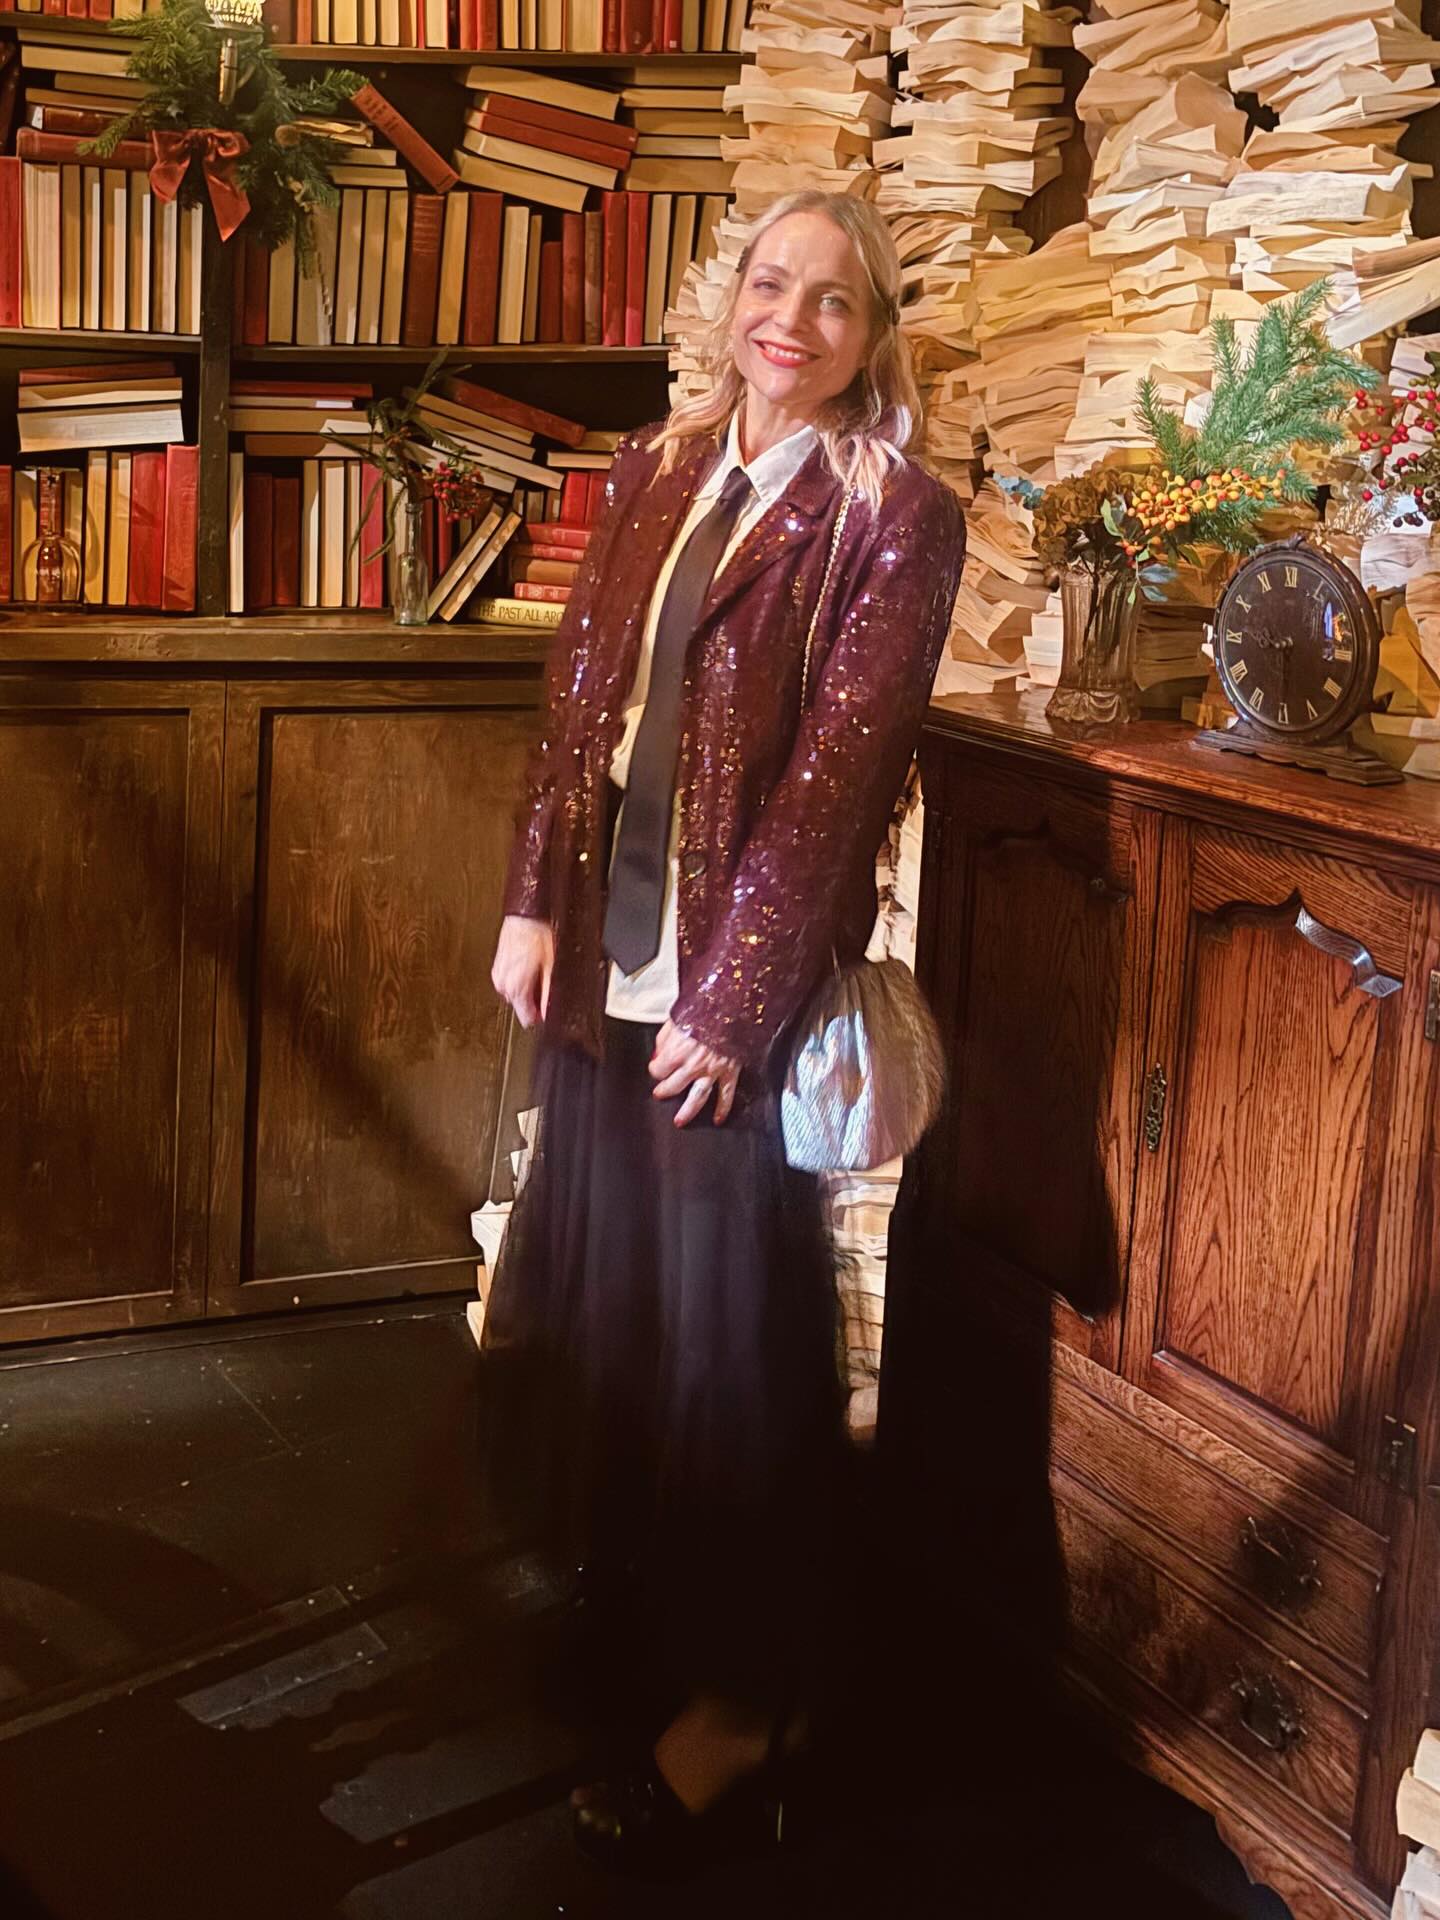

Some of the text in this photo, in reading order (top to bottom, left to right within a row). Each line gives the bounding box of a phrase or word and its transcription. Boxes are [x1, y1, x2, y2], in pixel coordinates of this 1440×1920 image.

[1257, 571, 1272, 593] XI
[1285, 566, 1297, 588] XII
[499, 606, 522, 620] PAST
[523, 607, 542, 622] ALL
[1235, 595, 1252, 614] X
[1226, 629, 1242, 644] IX
[1230, 659, 1248, 685] VIII
[1249, 687, 1264, 712] VII
[1306, 699, 1318, 721] V
